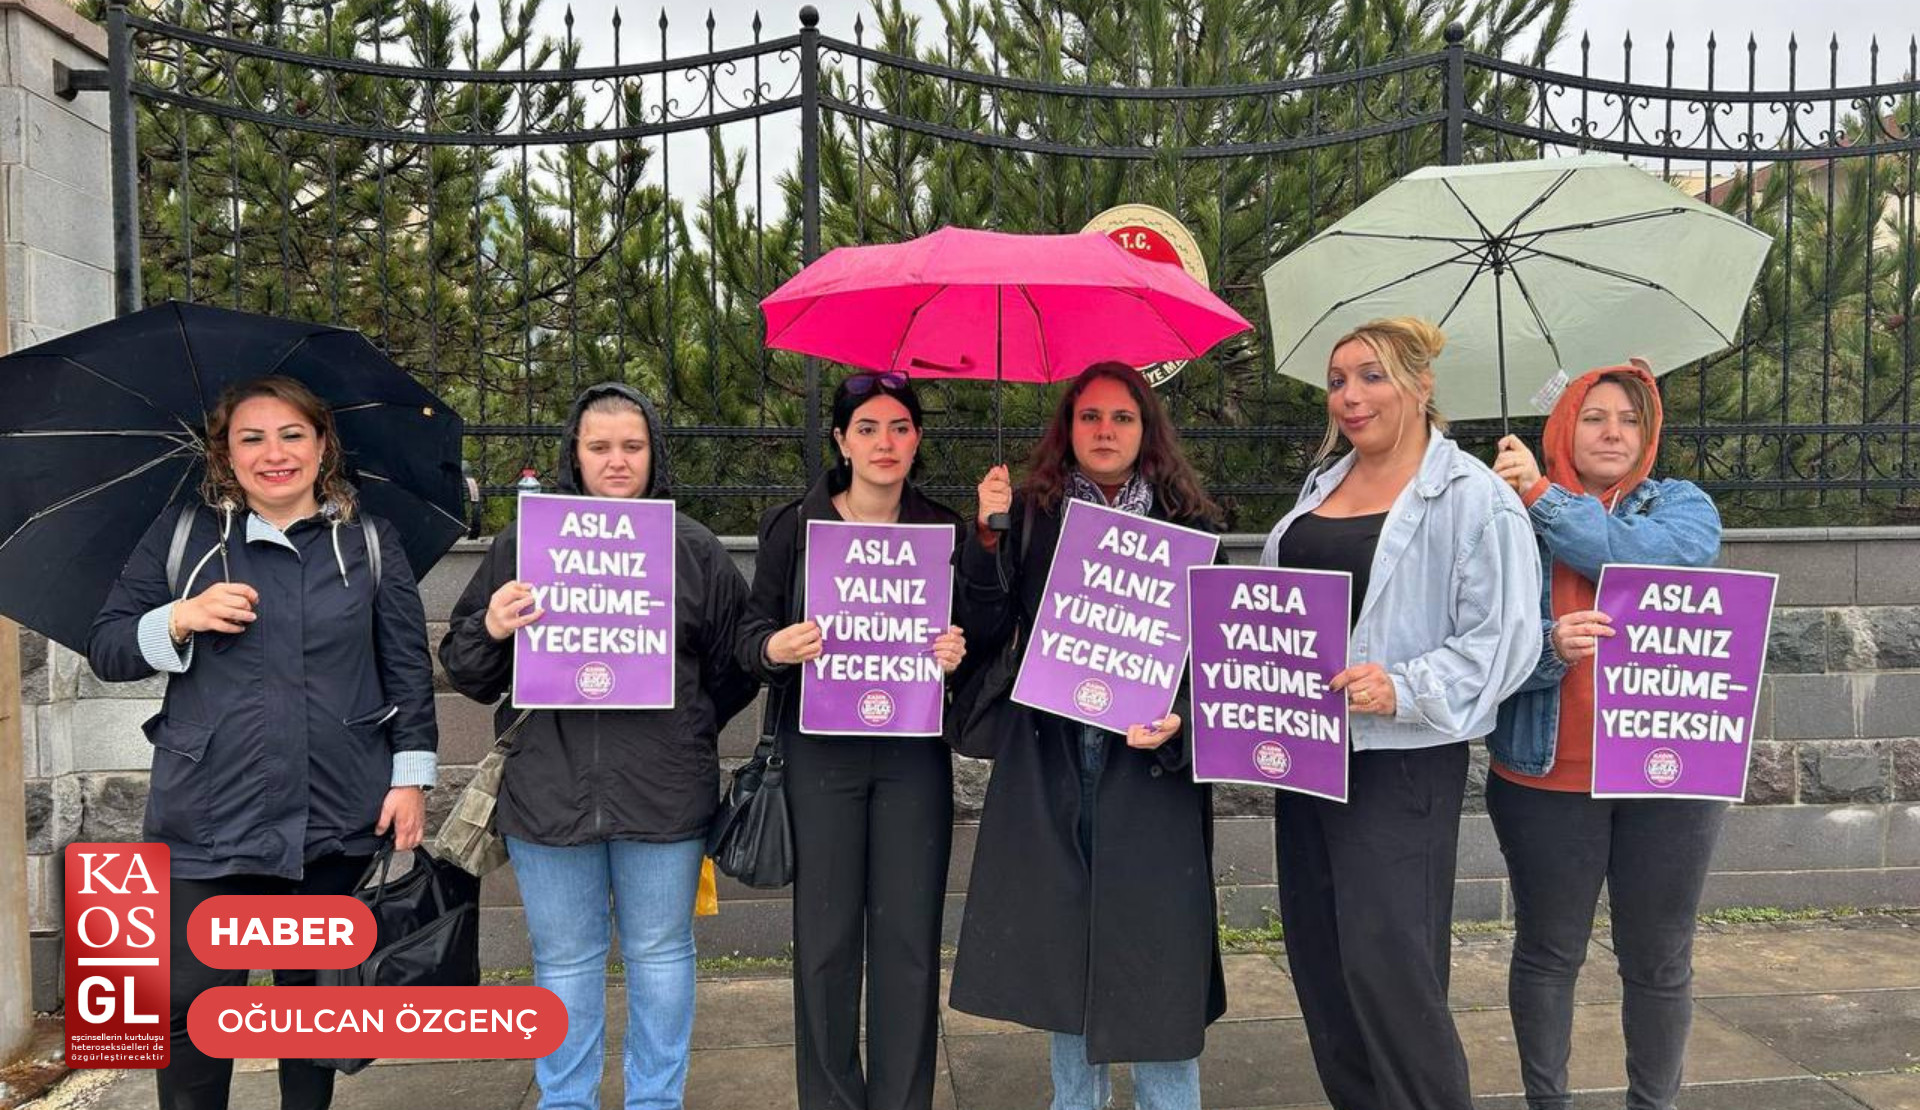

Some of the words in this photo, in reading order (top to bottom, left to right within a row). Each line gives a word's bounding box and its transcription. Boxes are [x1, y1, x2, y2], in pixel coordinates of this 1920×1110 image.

[1119, 232, 1151, 250] T.C.
[560, 512, 635, 540] ASLA
[845, 539, 916, 566] ASLA
[1098, 526, 1170, 567] ASLA
[549, 549, 647, 578] YALNIZ
[531, 582, 665, 616] YÜRÜME-
[834, 577, 926, 604] YALNIZ
[1082, 559, 1175, 608] YALNIZ
[1231, 583, 1306, 615] ASLA
[1638, 583, 1723, 615] ASLA
[816, 611, 941, 643] YÜRÜME-
[1053, 593, 1181, 647] YÜRÜME-
[526, 624, 666, 654] YECEKSİN
[1220, 624, 1317, 658] YALNIZ
[1626, 625, 1733, 658] YALNIZ
[814, 653, 942, 682] YECEKSİN
[1040, 629, 1175, 689] YECEKSİN
[1604, 662, 1747, 700] YÜRÜME-
[1200, 702, 1340, 743] YECEKSİN
[1601, 709, 1744, 743] YECEKSİN
